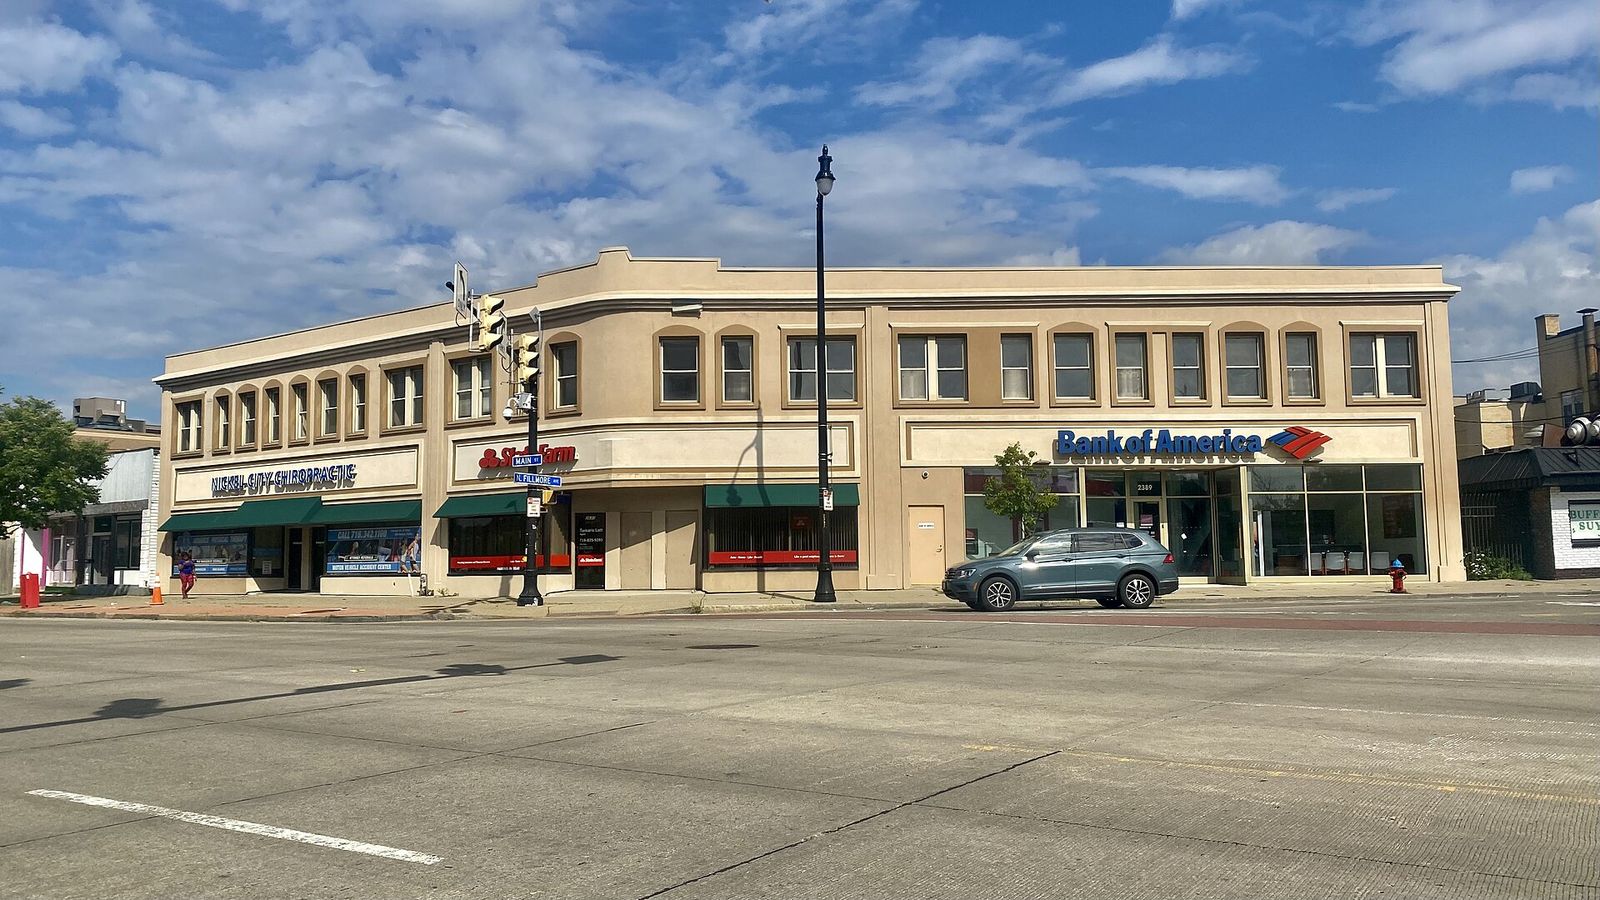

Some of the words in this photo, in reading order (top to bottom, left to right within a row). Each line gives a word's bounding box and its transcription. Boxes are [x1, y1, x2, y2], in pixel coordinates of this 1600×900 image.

[1058, 430, 1123, 454] Bank
[1125, 429, 1152, 454] of
[1156, 429, 1262, 454] America
[515, 457, 532, 465] MAIN
[211, 475, 246, 491] NICKEL
[247, 471, 274, 489] CITY
[274, 464, 357, 486] CHIROPRACTIC
[523, 475, 551, 484] FILLMORE
